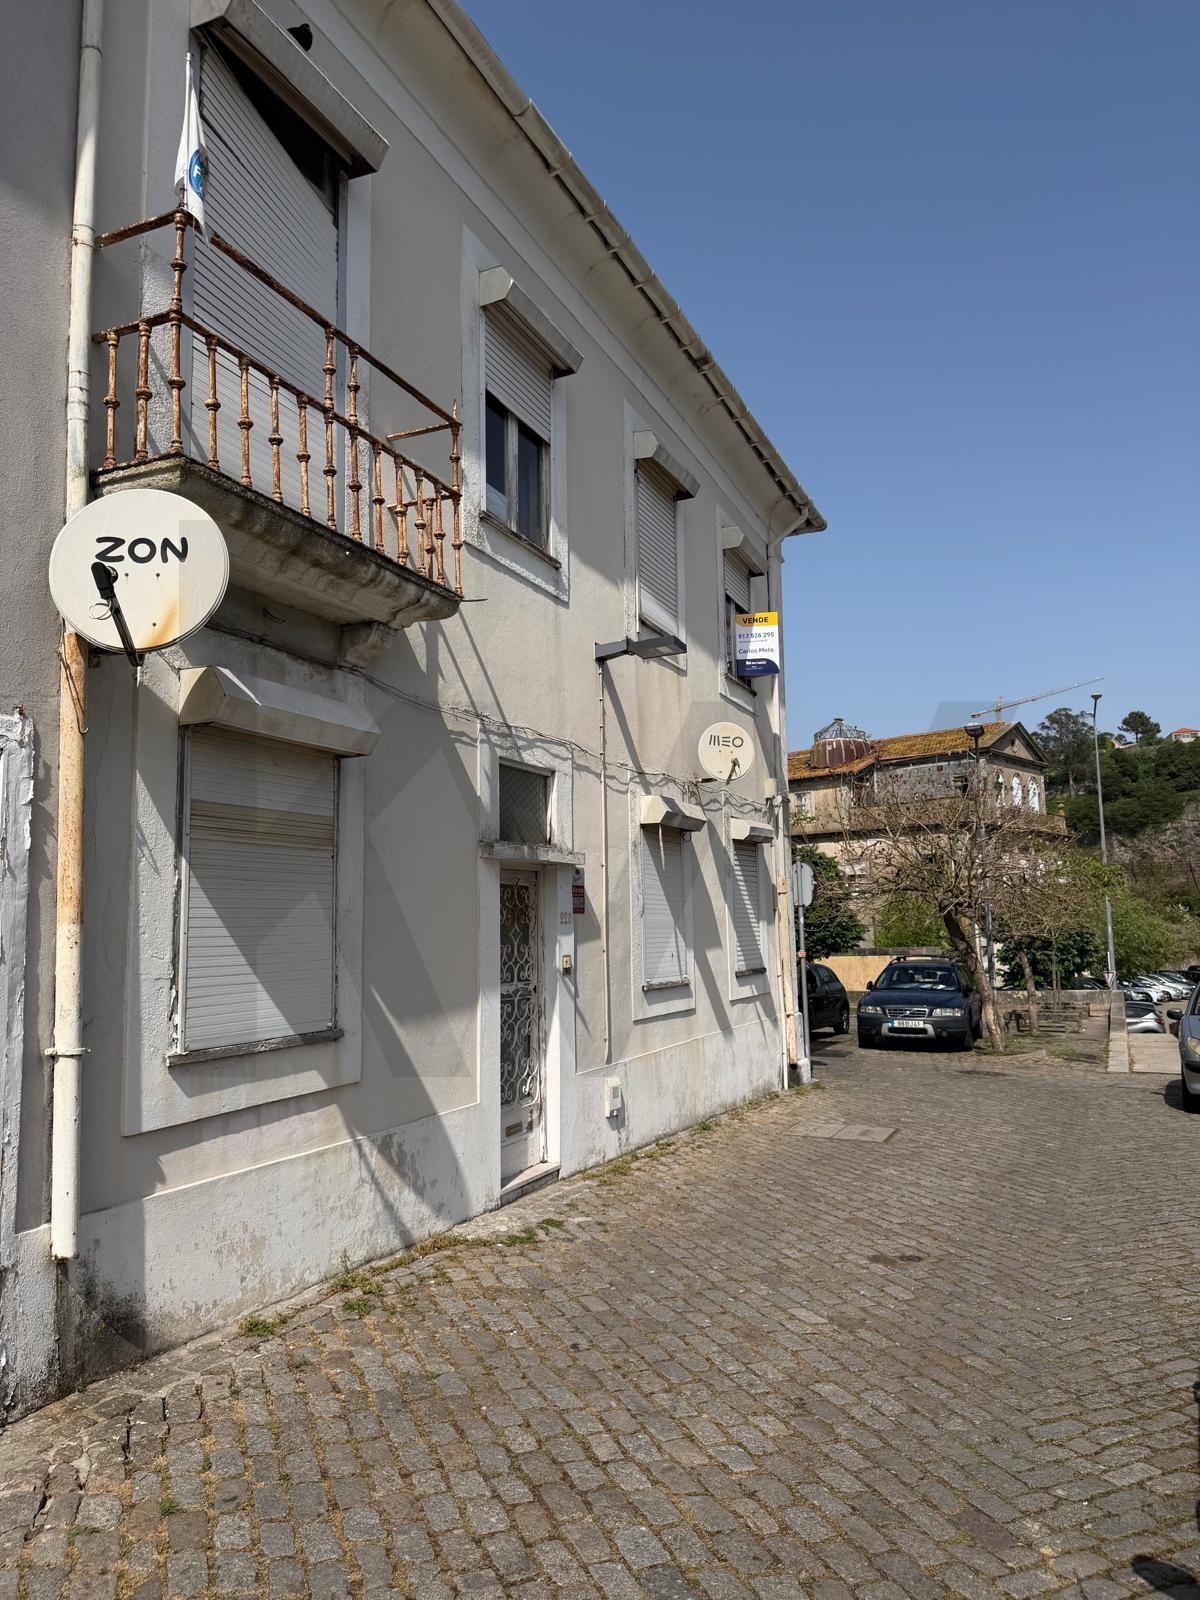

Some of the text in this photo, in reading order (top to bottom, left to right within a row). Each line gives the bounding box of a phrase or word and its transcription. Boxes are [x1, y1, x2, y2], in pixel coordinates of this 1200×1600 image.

[95, 536, 189, 564] ZON
[742, 616, 769, 624] VENDE
[709, 734, 744, 748] MEO
